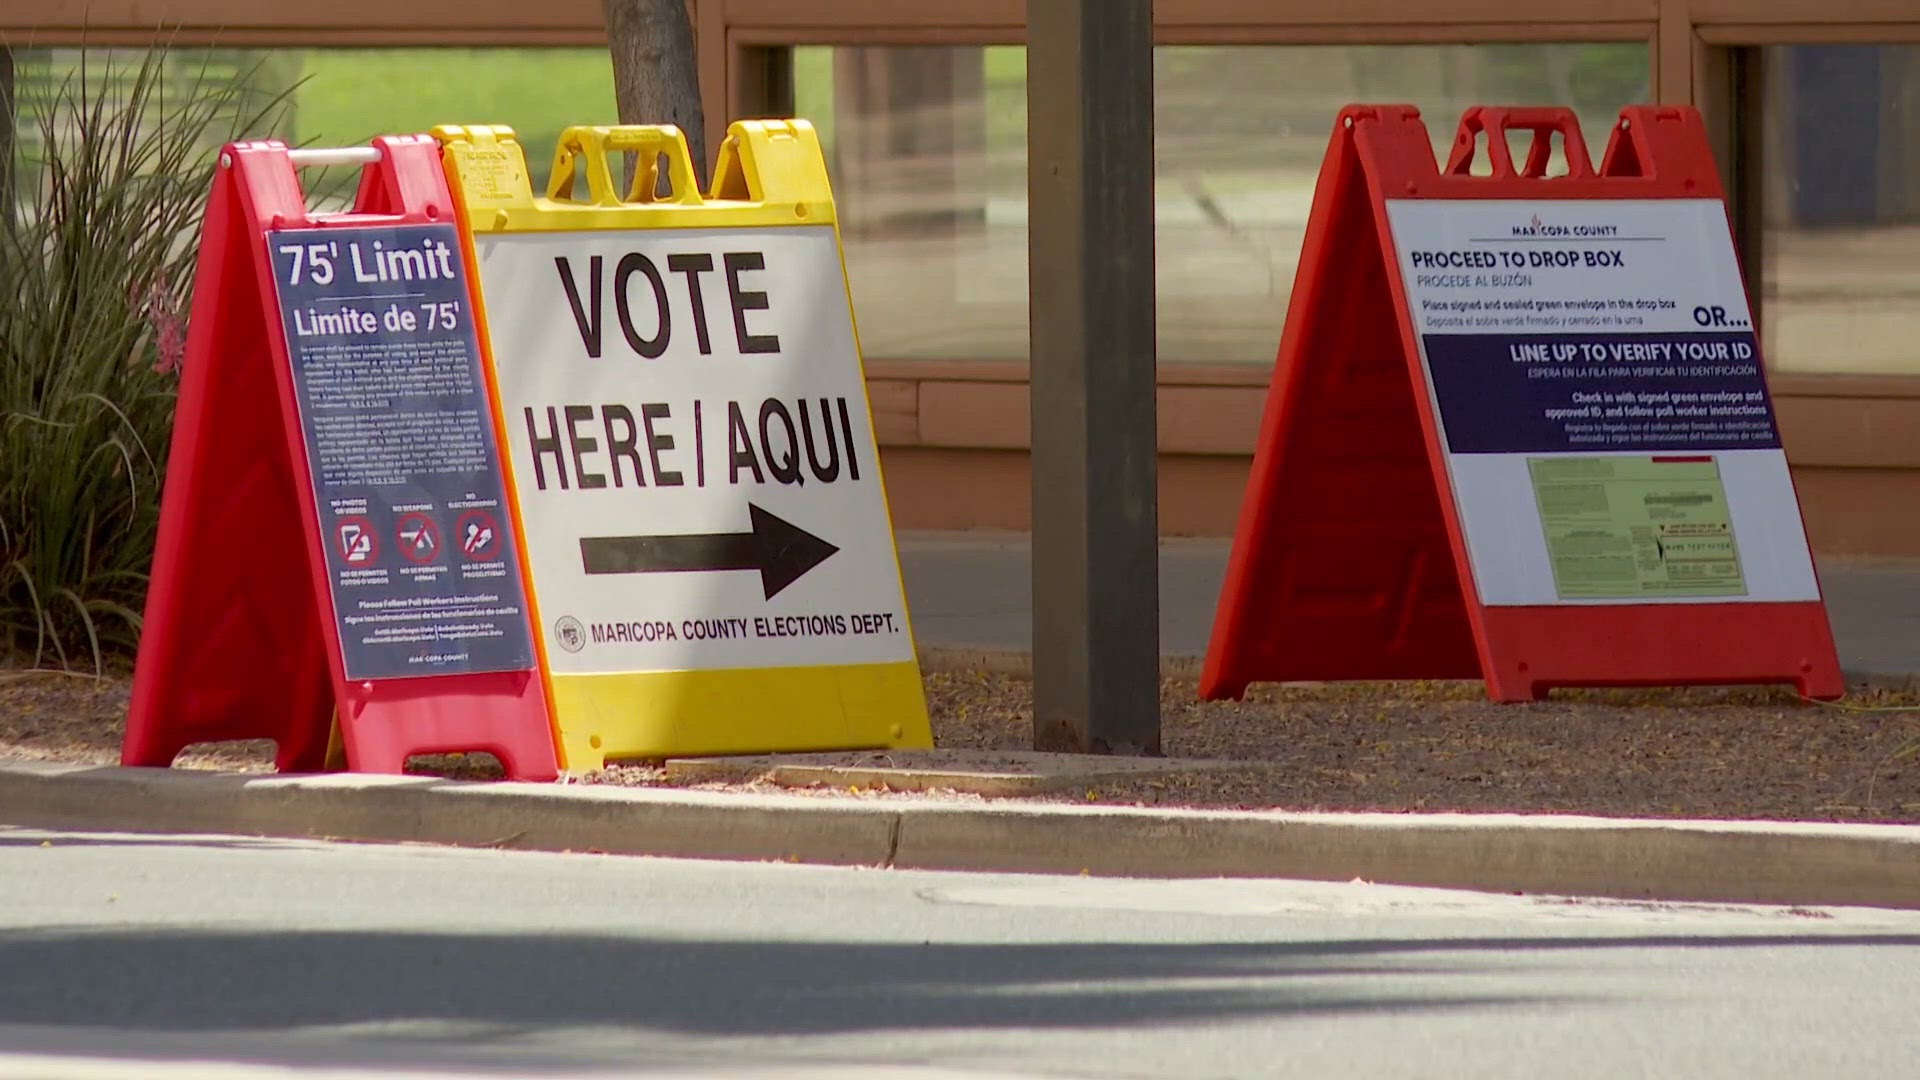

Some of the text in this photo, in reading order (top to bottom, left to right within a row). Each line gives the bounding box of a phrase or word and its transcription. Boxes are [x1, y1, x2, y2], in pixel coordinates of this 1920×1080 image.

[1573, 225, 1618, 237] COUNTY
[279, 238, 455, 286] 75' Limit
[1411, 250, 1625, 269] PROCEED TO DROP BOX
[1417, 271, 1533, 288] PROCEDE AL BUZÓN
[555, 252, 781, 360] VOTE
[1422, 299, 1448, 311] Place
[1450, 299, 1482, 313] signed
[1484, 299, 1501, 310] and
[1503, 299, 1534, 310] sealed
[1536, 301, 1563, 312] green
[1564, 299, 1606, 312] envelope
[1608, 299, 1617, 310] in
[1618, 299, 1634, 309] the
[1636, 299, 1657, 312] drop
[294, 301, 460, 336] Limite de 75'
[1526, 314, 1560, 326] firmado
[1562, 317, 1568, 327] y
[1602, 317, 1613, 325] en
[1614, 315, 1623, 325] la
[1693, 306, 1748, 327] OR...
[1510, 342, 1752, 363] LINE UP TO VERIFY YOUR ID
[1632, 366, 1676, 377] VERIFICAR
[1677, 366, 1689, 377] TU
[1690, 364, 1757, 377] IDENTIFICACIÓN
[1572, 389, 1763, 405] Check in with signed green envelope and
[1544, 408, 1590, 421] approved
[1605, 407, 1623, 418] and
[1624, 406, 1654, 418] follow
[1655, 406, 1675, 419] poll
[1676, 406, 1708, 416] worker
[1709, 404, 1767, 416] instructions
[524, 403, 685, 491] HERE
[727, 396, 860, 488] AQUI
[465, 493, 476, 501] NO
[359, 600, 383, 609] Please
[383, 599, 408, 608] Follow
[408, 598, 422, 607] Poll
[591, 622, 678, 644] MARICOPA
[683, 618, 748, 641] COUNTY
[754, 614, 847, 638] ELECTIONS
[851, 612, 900, 635] DEPT.
[409, 655, 442, 664] MARCOPA
[443, 653, 469, 662] COUNTY
